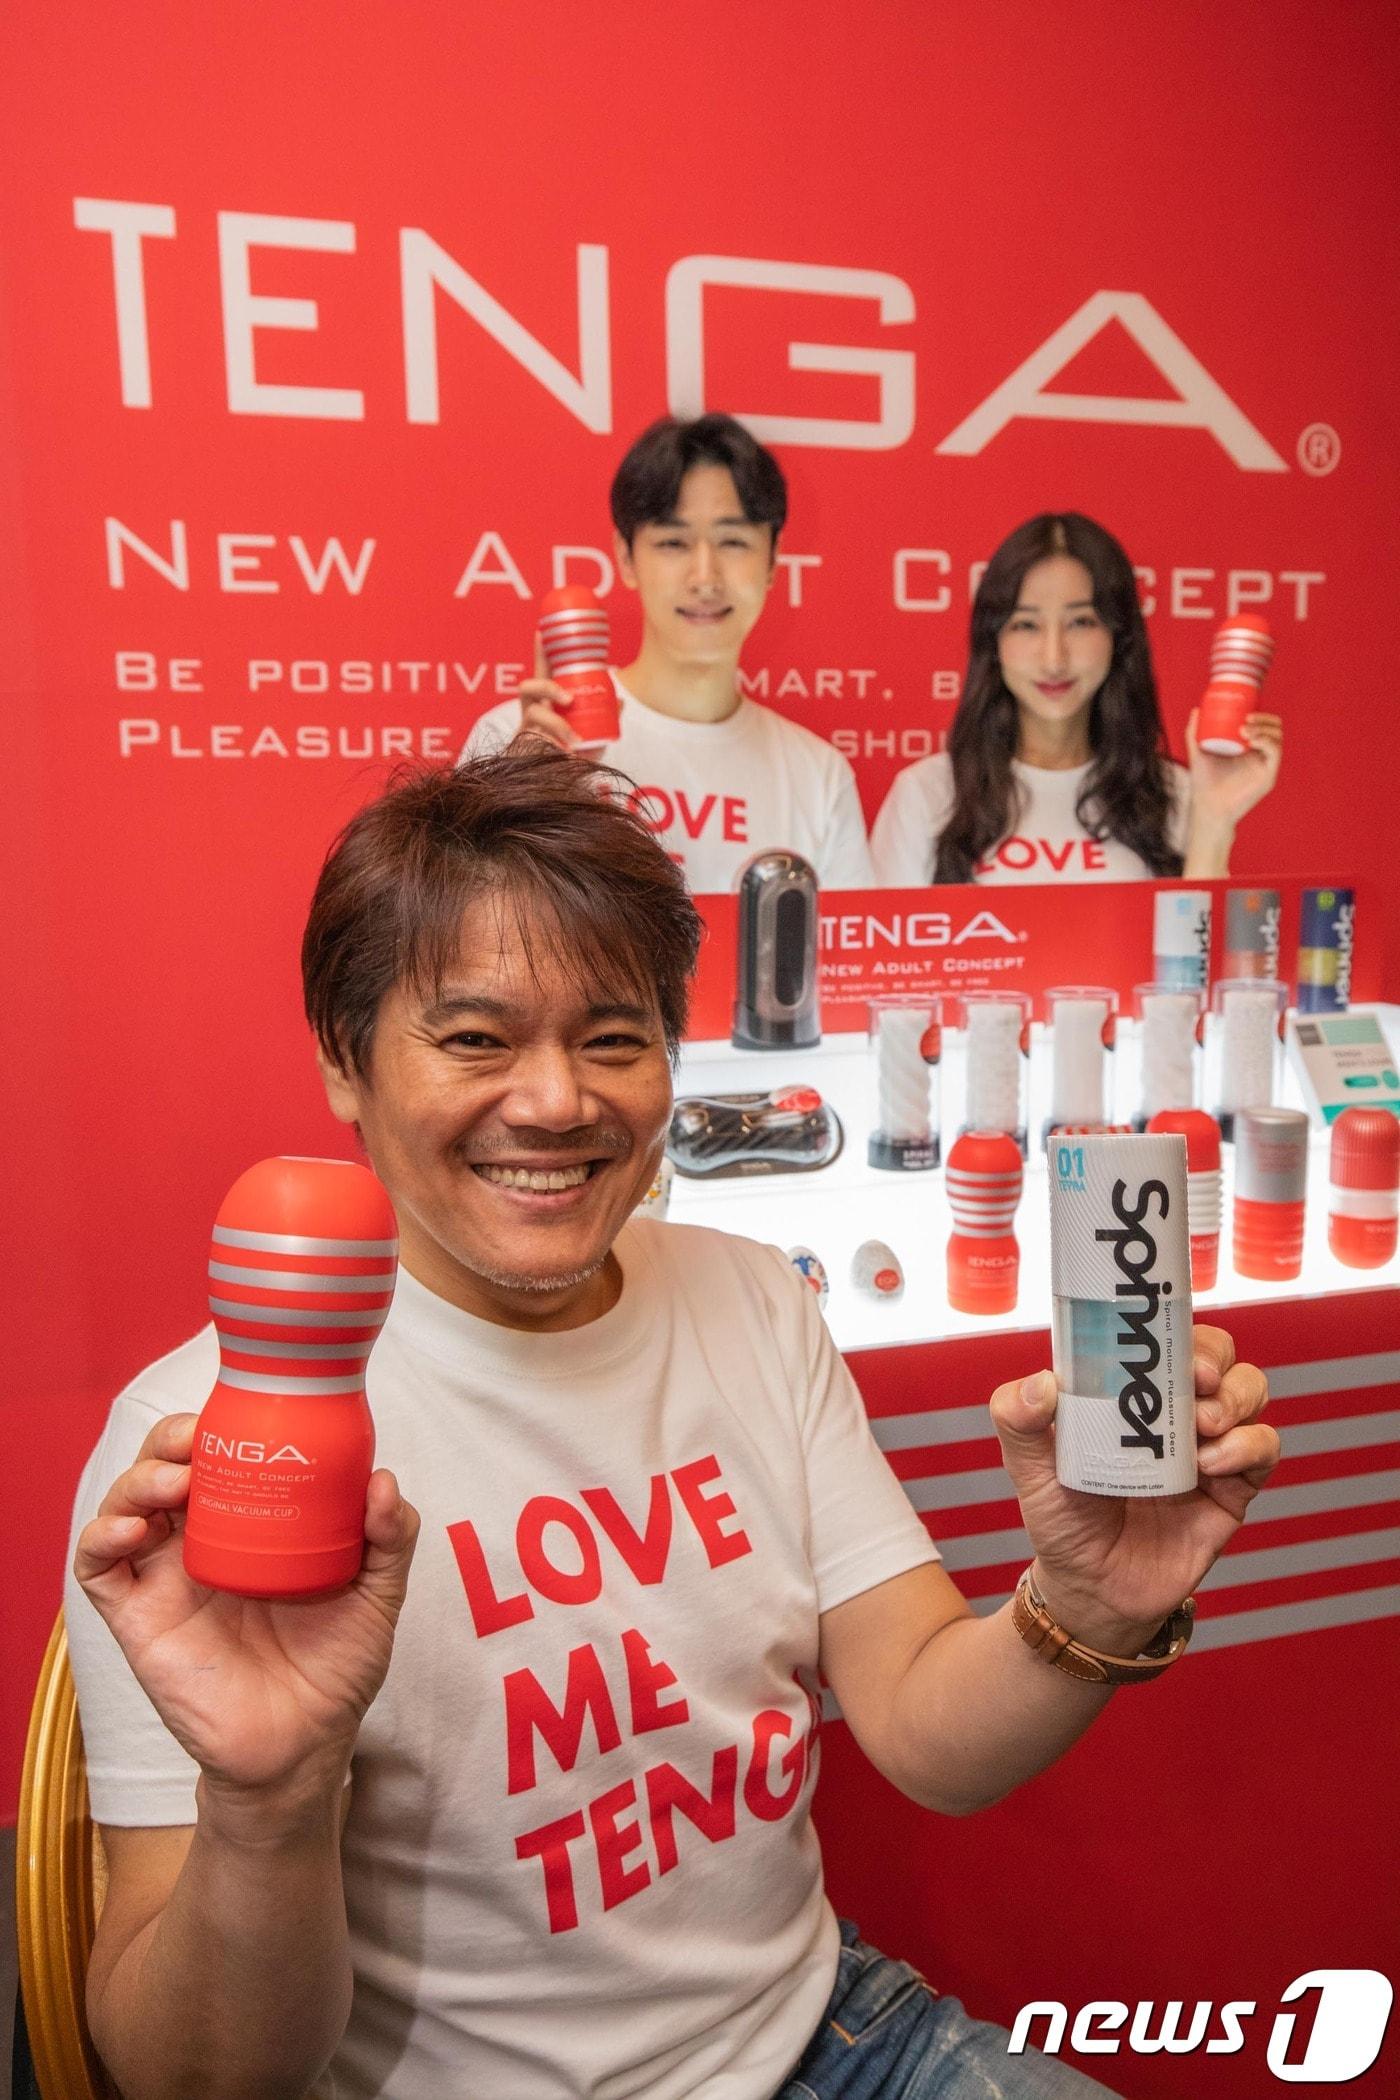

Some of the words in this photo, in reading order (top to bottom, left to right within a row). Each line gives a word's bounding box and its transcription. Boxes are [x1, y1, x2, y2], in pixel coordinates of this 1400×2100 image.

[105, 517, 376, 595] NEW
[454, 531, 822, 608] ADT
[115, 651, 204, 692] BE
[248, 660, 525, 694] POSITIVE
[737, 667, 894, 699] MART.
[118, 718, 451, 758] PLEASURE
[872, 960, 933, 976] ADULT
[943, 956, 1026, 973] CONCEPT
[1057, 1147, 1085, 1177] 01
[1095, 1178, 1173, 1460] Spinner
[1164, 1300, 1172, 1332] Spiral
[1168, 1379, 1176, 1426] Pleasure
[201, 1431, 310, 1465] TENGA
[217, 1465, 251, 1479] ADULT
[259, 1472, 316, 1482] CONCEPT
[198, 1495, 229, 1512] ORIGINAL
[232, 1503, 271, 1516] VACUUM
[274, 1508, 293, 1517] CUP
[446, 1454, 753, 1639] LOVE
[503, 1628, 690, 1796] ME
